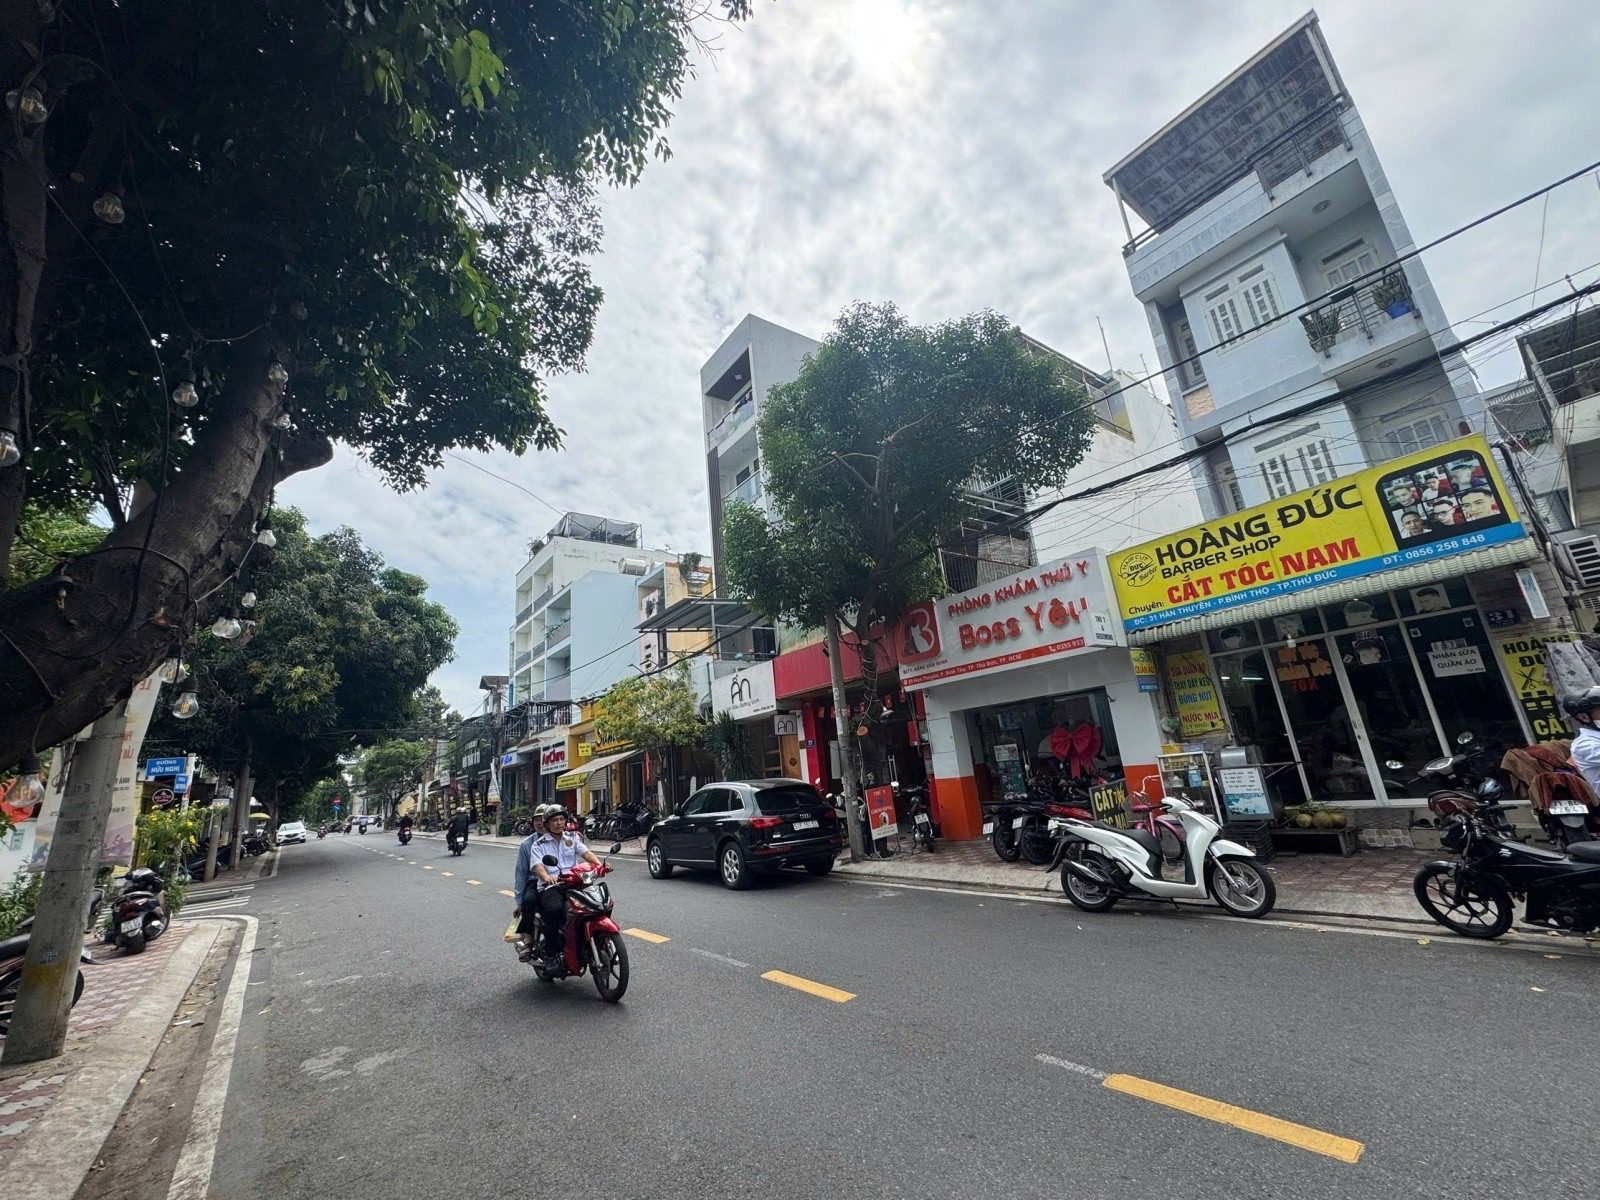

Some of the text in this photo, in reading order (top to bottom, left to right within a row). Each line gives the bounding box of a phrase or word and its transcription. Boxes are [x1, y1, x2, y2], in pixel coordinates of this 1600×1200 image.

[1156, 484, 1363, 566] HOÀNG ĐỨC
[1162, 535, 1282, 579] BARBER SHOP
[1383, 534, 1486, 566] ĐT: 0856 258 848
[1167, 537, 1361, 604] CẮT TÓC NAM
[948, 560, 1089, 618] PHÒNG KHÁM THÚ Y
[1160, 610, 1176, 620] HÀN
[1315, 569, 1338, 582] ĐỨC
[1128, 601, 1164, 615] Chuyên:
[1488, 609, 1514, 621] 31
[1519, 649, 1548, 667] ĐỨ
[1182, 713, 1203, 723] NƯỚC
[151, 765, 180, 773] HỮU NGHỊ
[1094, 786, 1114, 812] CẮT
